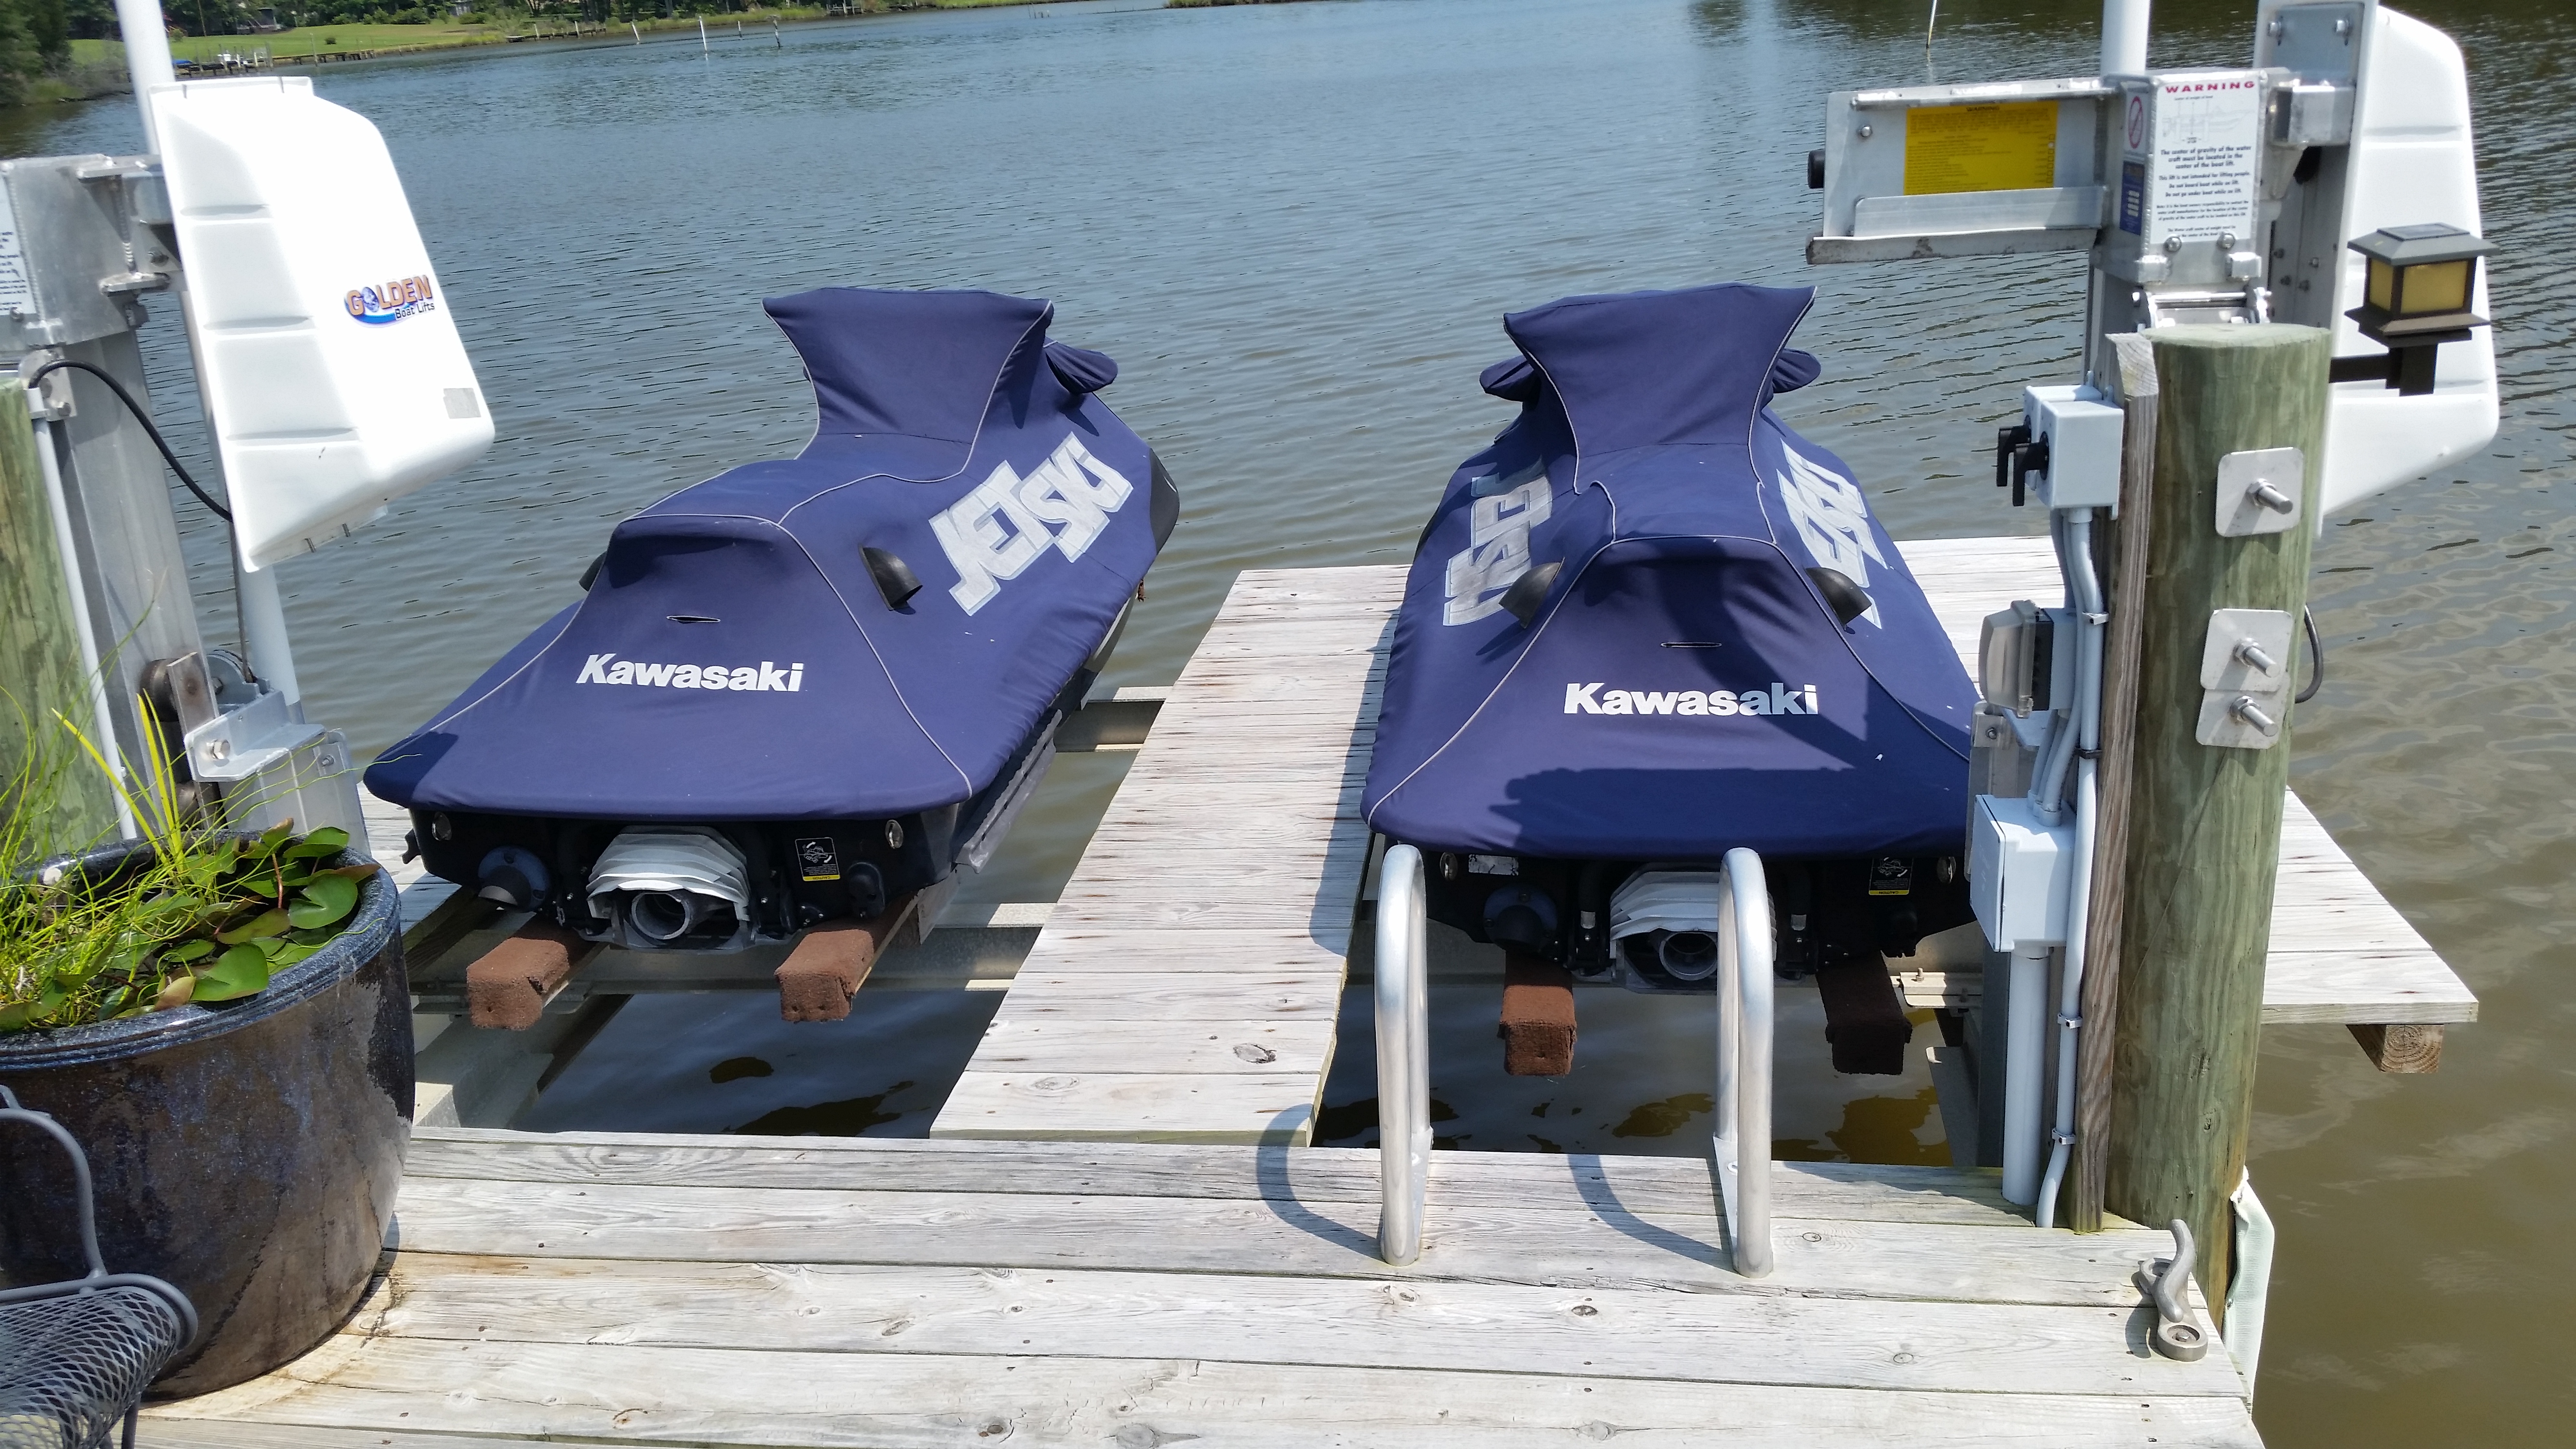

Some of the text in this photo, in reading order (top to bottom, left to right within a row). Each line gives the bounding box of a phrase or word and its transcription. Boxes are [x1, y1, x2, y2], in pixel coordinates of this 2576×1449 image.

[2166, 81, 2255, 93] WARNING
[345, 274, 433, 316] GOLDEN
[395, 301, 435, 320] Boat Lifts
[576, 653, 804, 692] Kawasaki
[1563, 682, 1819, 716] Kawasaki
